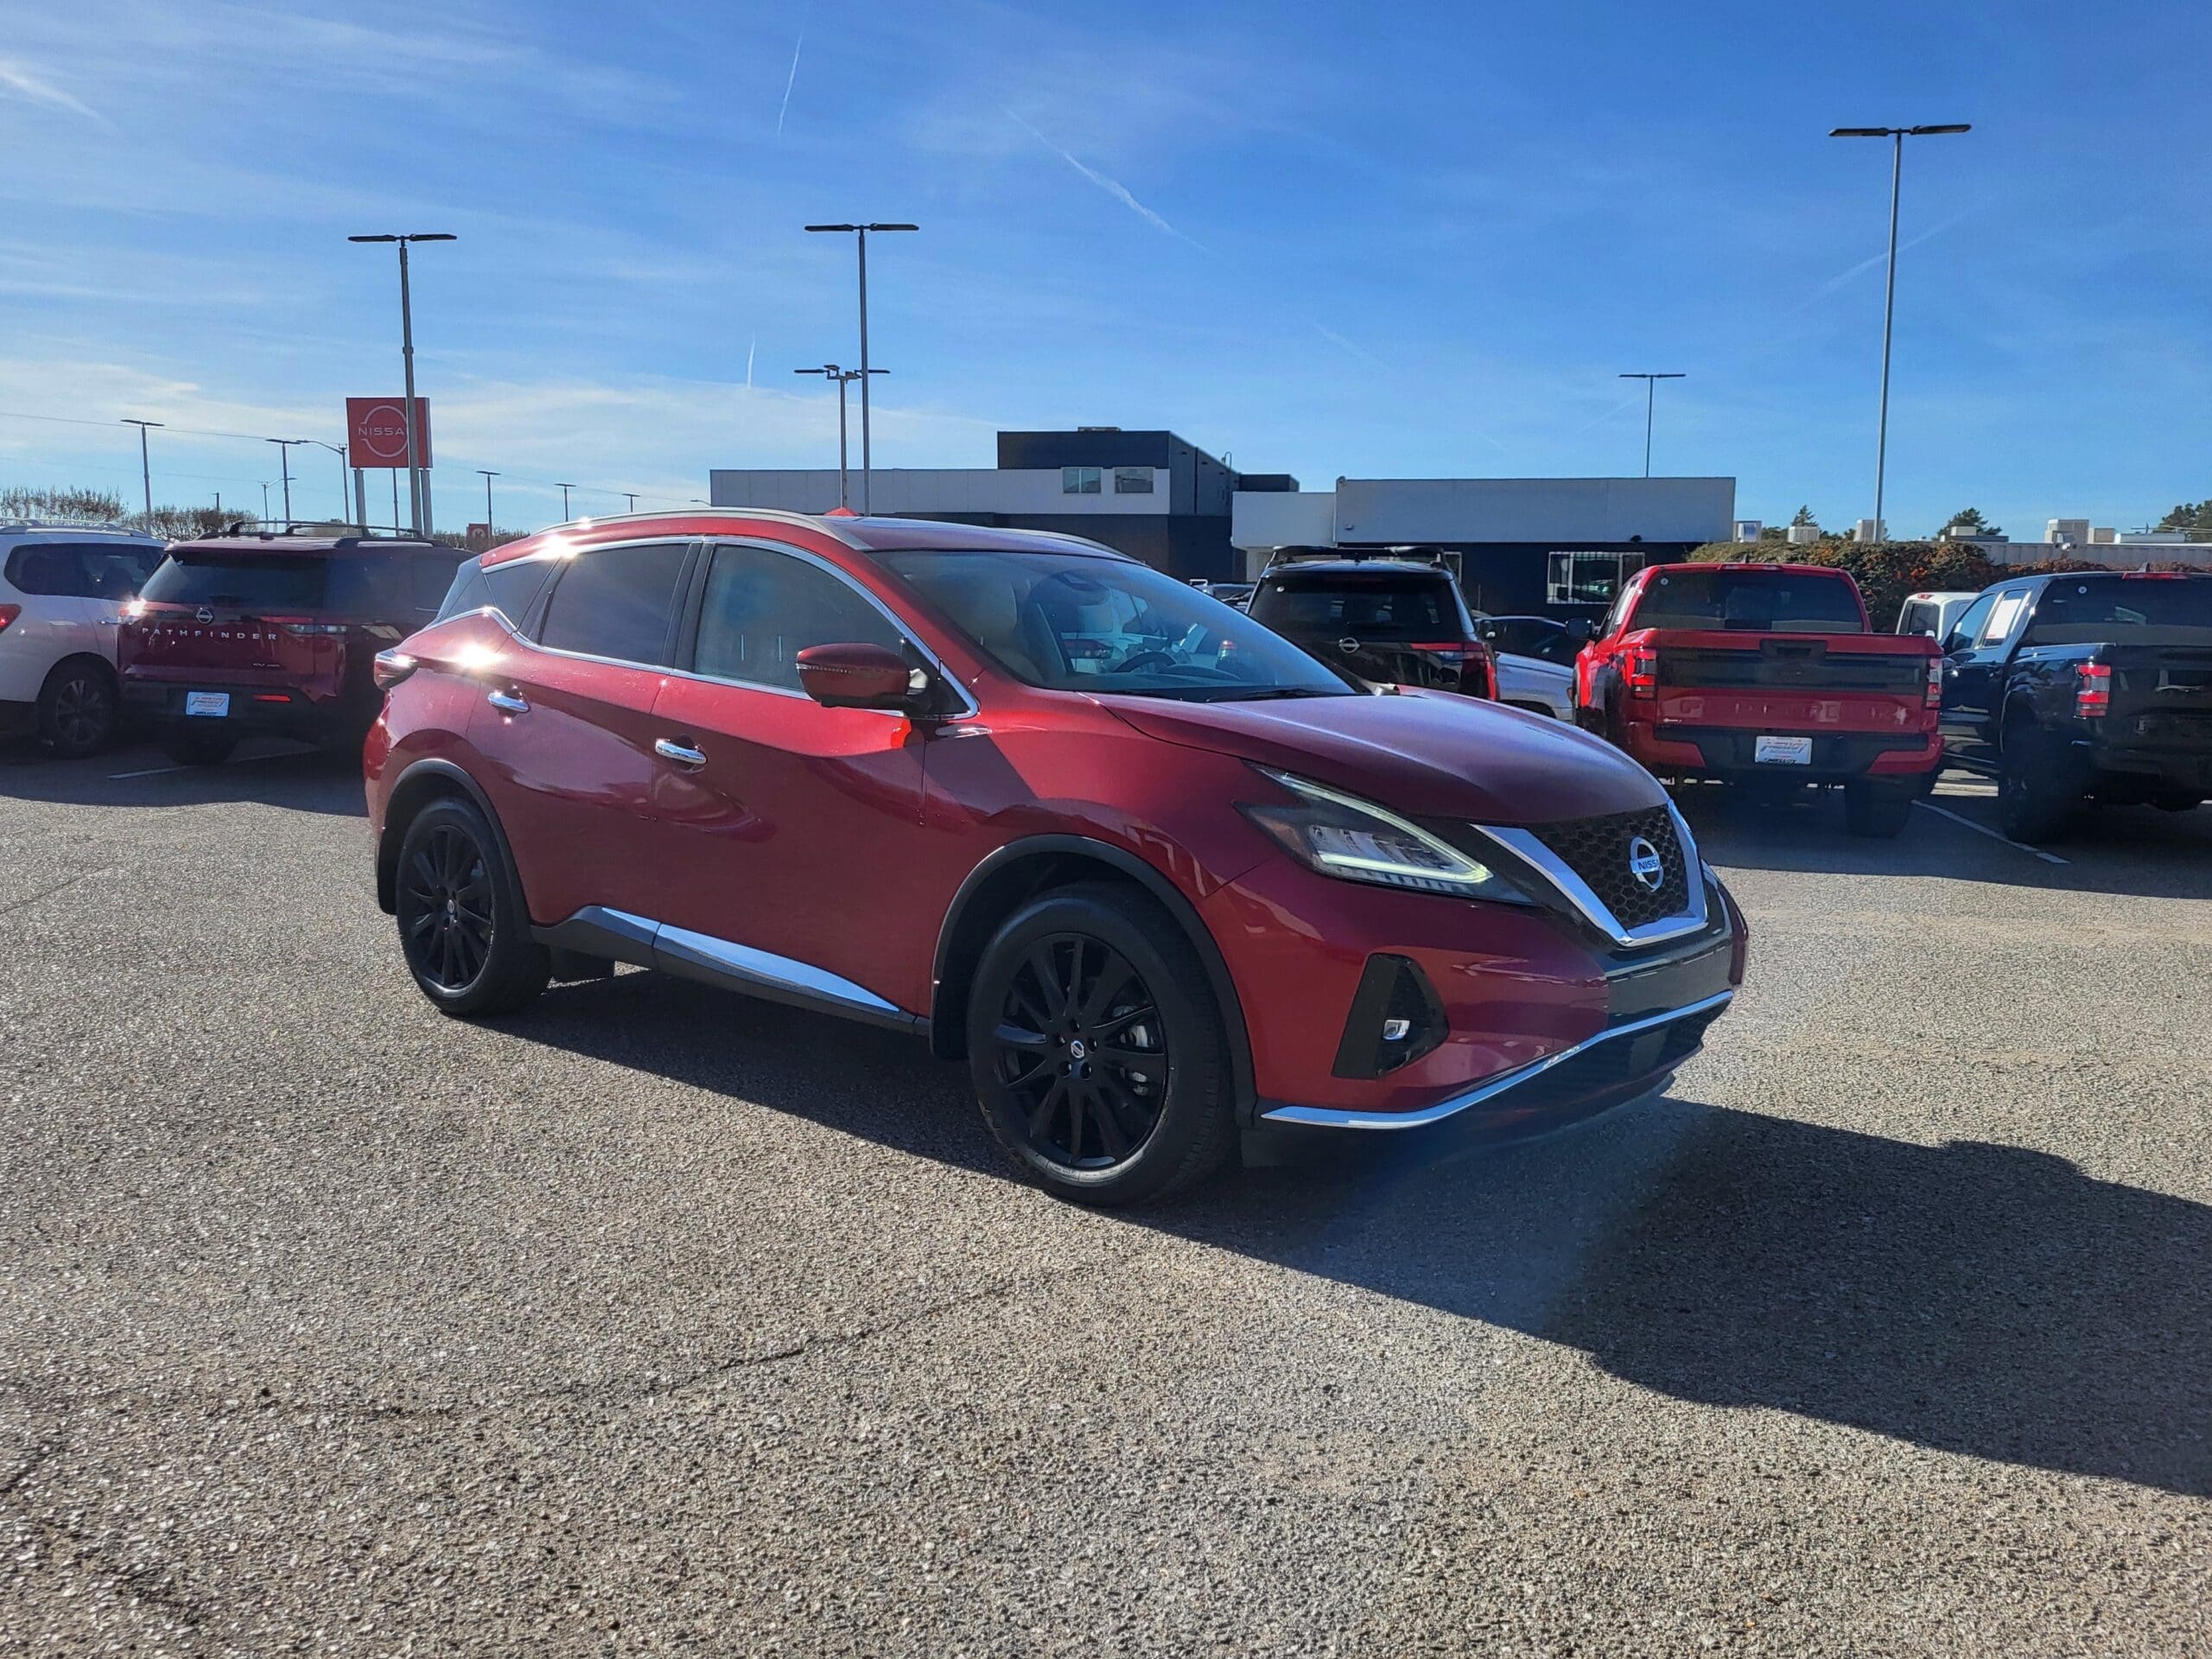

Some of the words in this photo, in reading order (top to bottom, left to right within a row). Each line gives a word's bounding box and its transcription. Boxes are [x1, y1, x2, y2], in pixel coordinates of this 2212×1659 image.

[358, 427, 406, 436] NISSA
[142, 627, 277, 641] PATHFINDER
[1637, 858, 1660, 870] NISS
